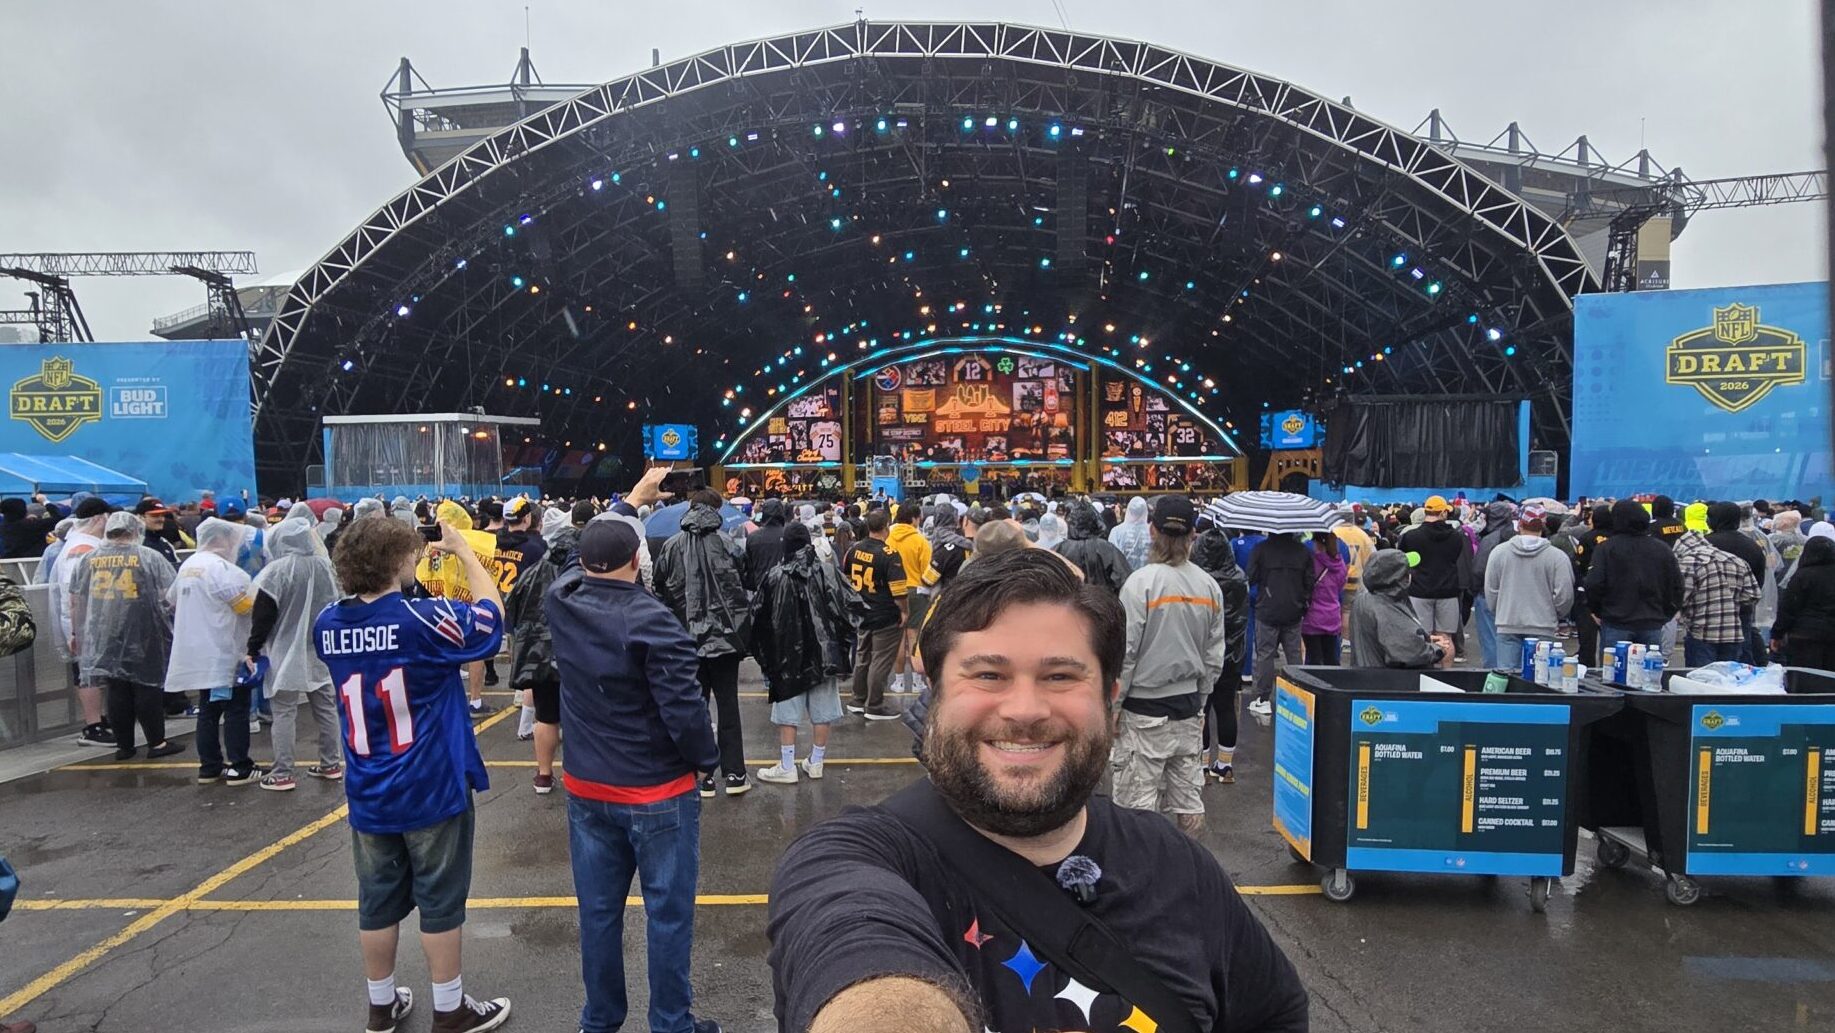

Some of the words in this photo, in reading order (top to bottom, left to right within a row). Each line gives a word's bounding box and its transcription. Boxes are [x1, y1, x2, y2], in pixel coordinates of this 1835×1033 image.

[1719, 322, 1750, 339] NFL
[964, 360, 981, 380] 12
[1677, 352, 1793, 374] DRAFT
[45, 371, 67, 386] NFL
[1720, 382, 1749, 390] 2026
[17, 395, 94, 411] DRAFT
[120, 390, 157, 402] BUD
[113, 402, 164, 415] LIGHT
[46, 418, 66, 426] 2026
[935, 418, 976, 433] STEEL
[980, 417, 1011, 432] CITY
[1104, 411, 1128, 427] 412
[819, 434, 834, 448] 75
[1177, 428, 1195, 443] 32
[89, 555, 124, 569] PORTER
[93, 569, 139, 600] 24
[851, 563, 877, 594] 54
[322, 624, 400, 655] BLEDSOE
[341, 667, 414, 758] 11
[1374, 744, 1406, 752] AQUAFINA
[1374, 751, 1400, 759] BOTTLED
[1481, 747, 1514, 755] AMERICAN
[1515, 747, 1532, 756] BEER
[1480, 768, 1510, 776] PREMIUM
[1510, 769, 1527, 777] BEER
[1359, 766, 1368, 802] BEVERAGES
[1465, 773, 1474, 802] ALCOHOL
[1700, 770, 1709, 807] BEVERAGES
[1809, 776, 1817, 804] ALCOHOL
[1479, 797, 1497, 805] HARD
[1498, 797, 1524, 805] SELTZER
[1478, 817, 1504, 825] CANNED
[1504, 818, 1534, 827] COCKTAIL
